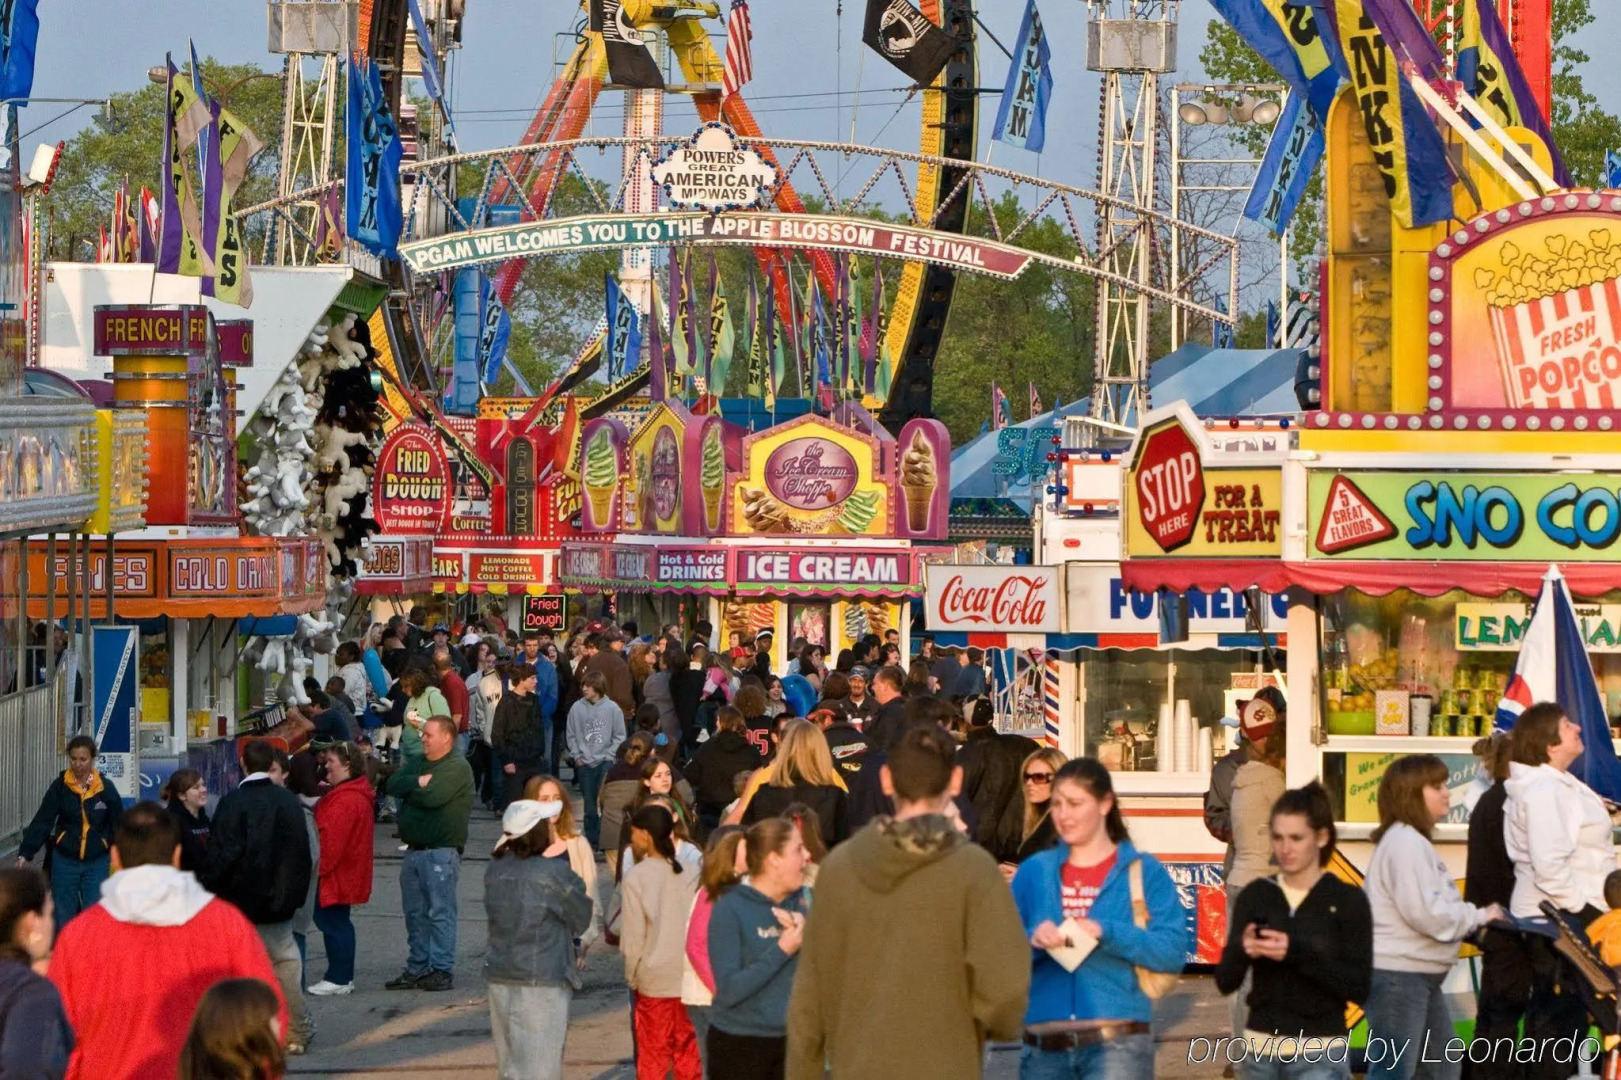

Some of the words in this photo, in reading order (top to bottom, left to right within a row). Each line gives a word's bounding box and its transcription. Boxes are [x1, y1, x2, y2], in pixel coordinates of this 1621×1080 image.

[683, 150, 746, 165] POWERS
[688, 163, 737, 172] GREAT
[663, 172, 764, 188] AMERICAN
[681, 188, 748, 200] MIDWAYS
[415, 241, 474, 267] PGAM
[475, 225, 584, 256] WELCOMES
[589, 224, 627, 243] YOU
[632, 222, 661, 241] TO
[663, 219, 705, 237] THE
[711, 217, 771, 238] APPLE
[779, 221, 875, 247] BLOSSOM
[890, 236, 985, 266] FESTIVAL
[106, 317, 181, 342] FRENCH
[1540, 315, 1596, 357] FRESH
[404, 439, 422, 449] The
[806, 441, 823, 456] the
[397, 447, 431, 473] FRIED
[515, 442, 527, 483] FRIED
[775, 457, 801, 477] Ice
[801, 457, 853, 477] Cream
[385, 473, 442, 500] DOUGH
[783, 478, 832, 503] Shoppe
[1140, 451, 1196, 522] STOP
[1214, 484, 1246, 508] FOR
[1251, 484, 1263, 508] A
[1339, 489, 1350, 507] 5
[390, 505, 434, 516] SHOP
[515, 489, 528, 532] DOUGH
[1332, 505, 1364, 525] GREAT
[1405, 480, 1522, 549] SNO
[453, 516, 486, 531] COFFEE
[1158, 512, 1189, 538] HERE
[1203, 510, 1280, 543] TREAT
[1330, 518, 1374, 541] FLAVORS
[481, 565, 499, 573] HOT
[502, 565, 533, 573] COFFEE
[483, 557, 531, 565] LEMONADE
[660, 554, 682, 564] Hot
[685, 555, 695, 564] &
[698, 554, 725, 564] Cold
[747, 555, 790, 580] ICE
[798, 555, 898, 581] CREAM
[175, 556, 229, 591] COLD
[477, 573, 500, 581] COLD
[502, 573, 537, 581] DRINKS
[659, 566, 725, 579] DRINKS
[530, 597, 559, 609] Fried
[939, 575, 1049, 625] Coca-Cola
[1110, 578, 1246, 619] FUNEL
[526, 613, 562, 627] Dough
[1358, 761, 1375, 775] We
